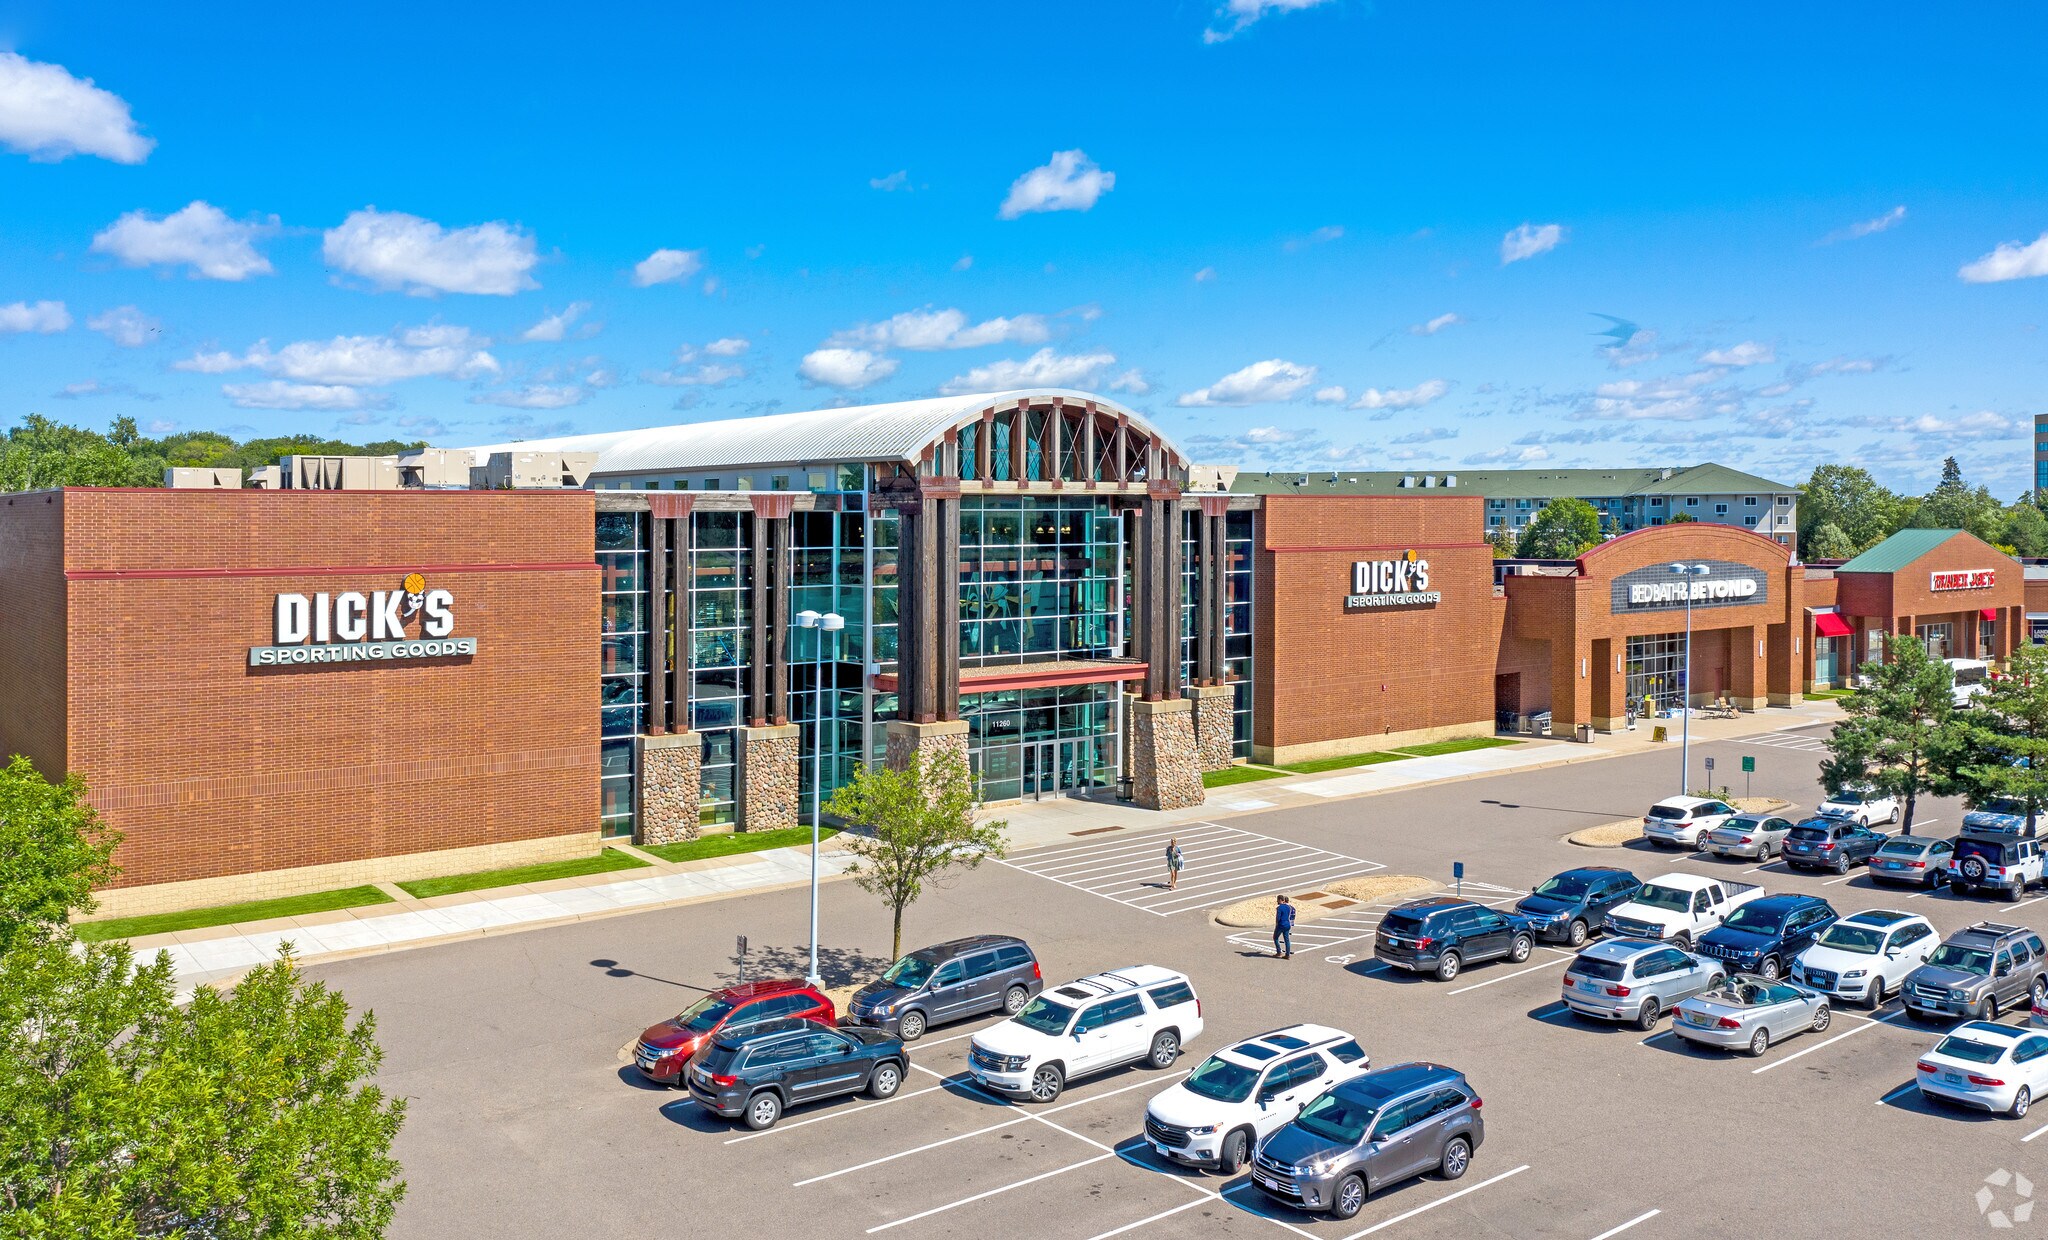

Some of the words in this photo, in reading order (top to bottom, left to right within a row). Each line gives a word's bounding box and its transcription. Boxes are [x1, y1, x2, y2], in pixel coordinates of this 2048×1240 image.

[1355, 553, 1429, 593] DICK'S
[1352, 596, 1403, 607] SPORTING
[1405, 592, 1440, 604] GOODS
[1631, 584, 1653, 603] BED
[1653, 582, 1680, 602] BATH
[1690, 578, 1758, 601] BEYOND
[276, 581, 455, 644] DICK'S
[259, 646, 384, 664] SPORTING
[391, 640, 471, 658] GOODS
[992, 719, 1011, 728] 11260
